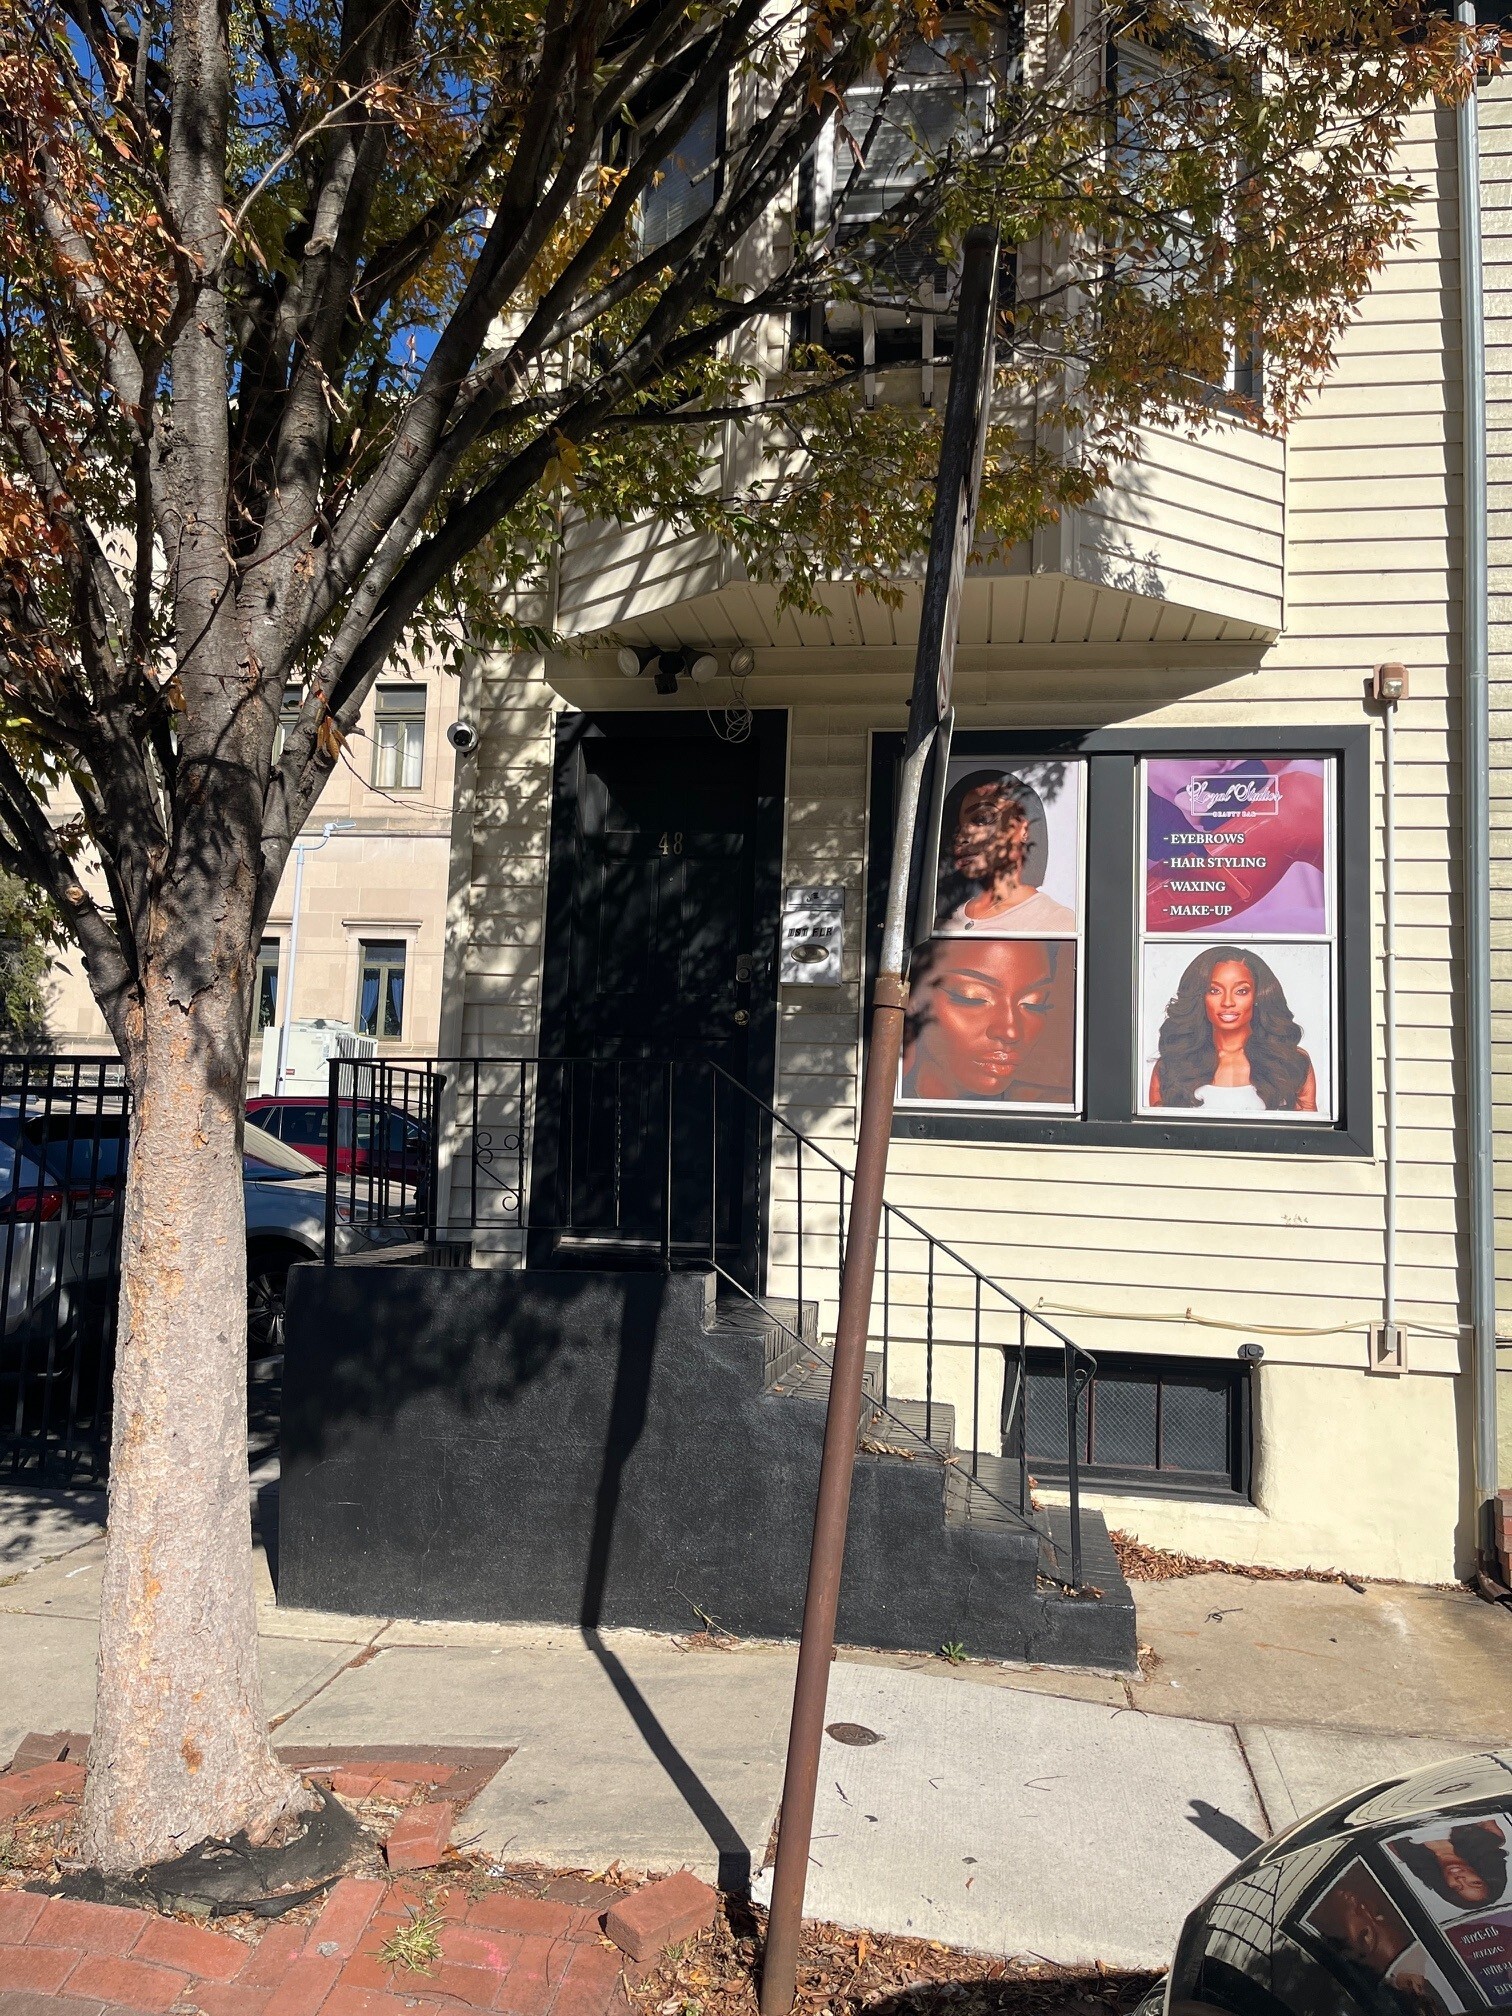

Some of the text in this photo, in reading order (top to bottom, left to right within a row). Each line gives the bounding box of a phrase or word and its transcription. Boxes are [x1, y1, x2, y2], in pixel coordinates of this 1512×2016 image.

[658, 832, 684, 855] 48
[1208, 858, 1266, 867] STYLING
[812, 926, 834, 938] FLR
